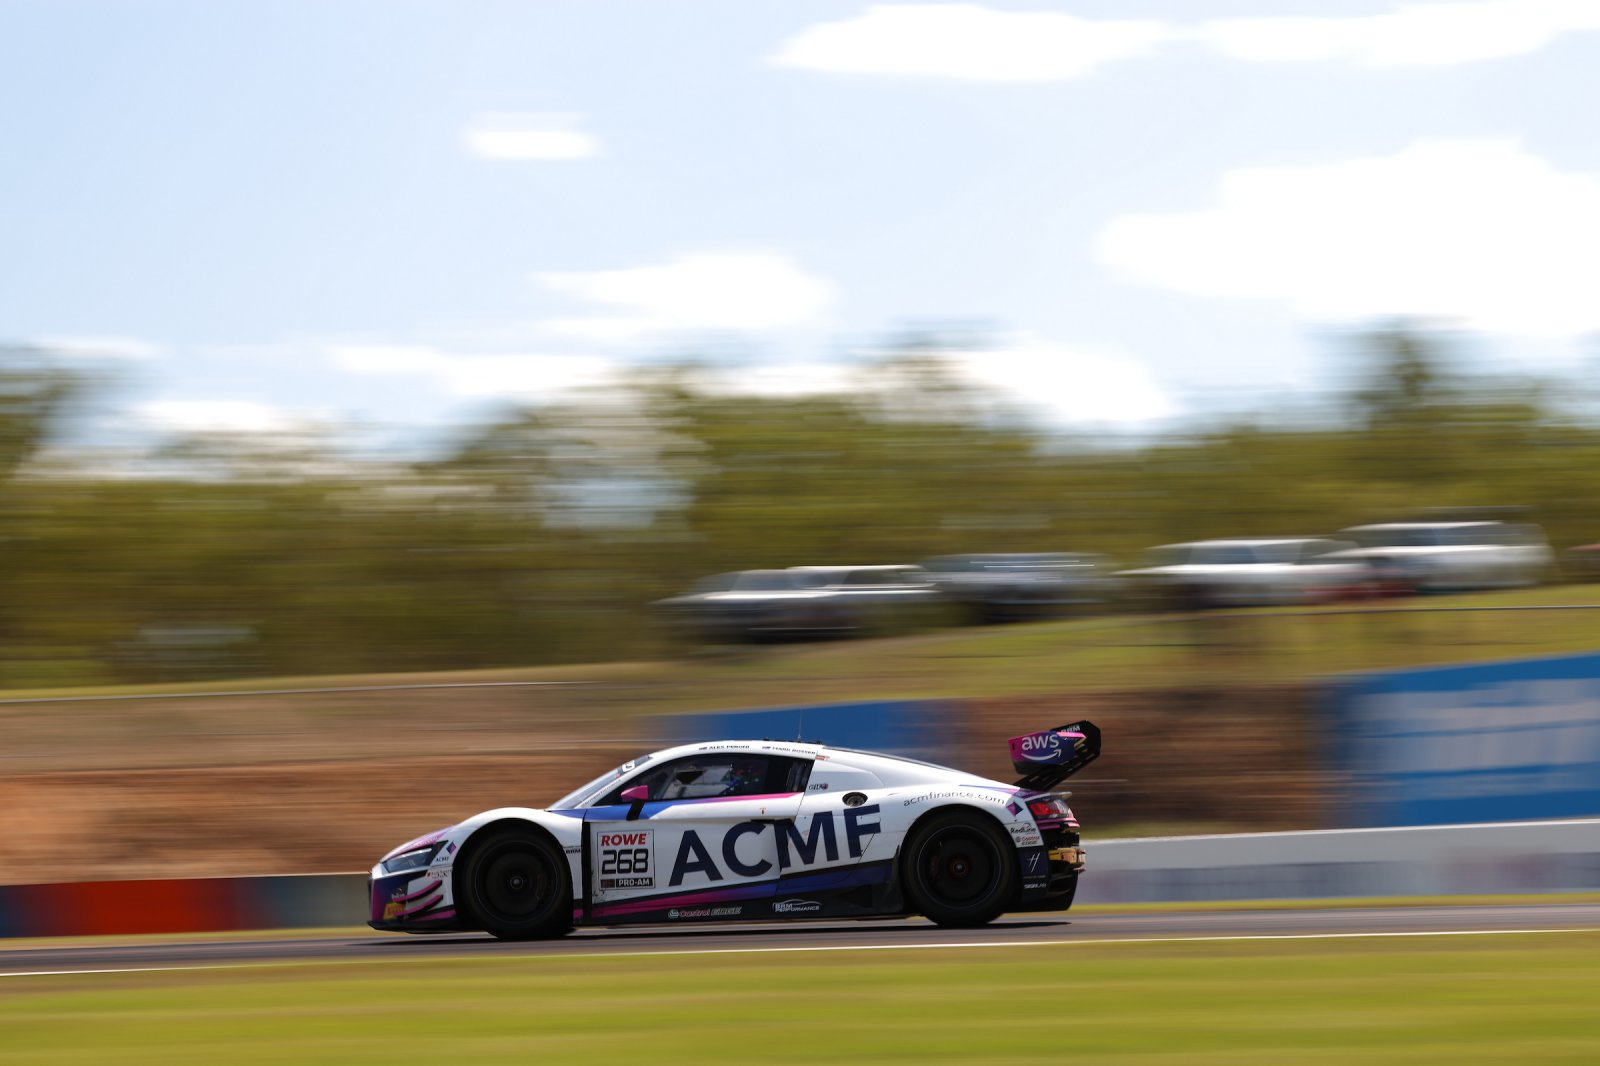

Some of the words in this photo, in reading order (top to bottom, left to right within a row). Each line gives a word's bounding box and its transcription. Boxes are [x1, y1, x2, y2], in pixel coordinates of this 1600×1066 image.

[1021, 734, 1060, 751] aws
[903, 791, 1005, 807] acmfinance.com
[601, 834, 646, 846] ROWE
[668, 803, 881, 887] ACMF
[601, 848, 648, 875] 268
